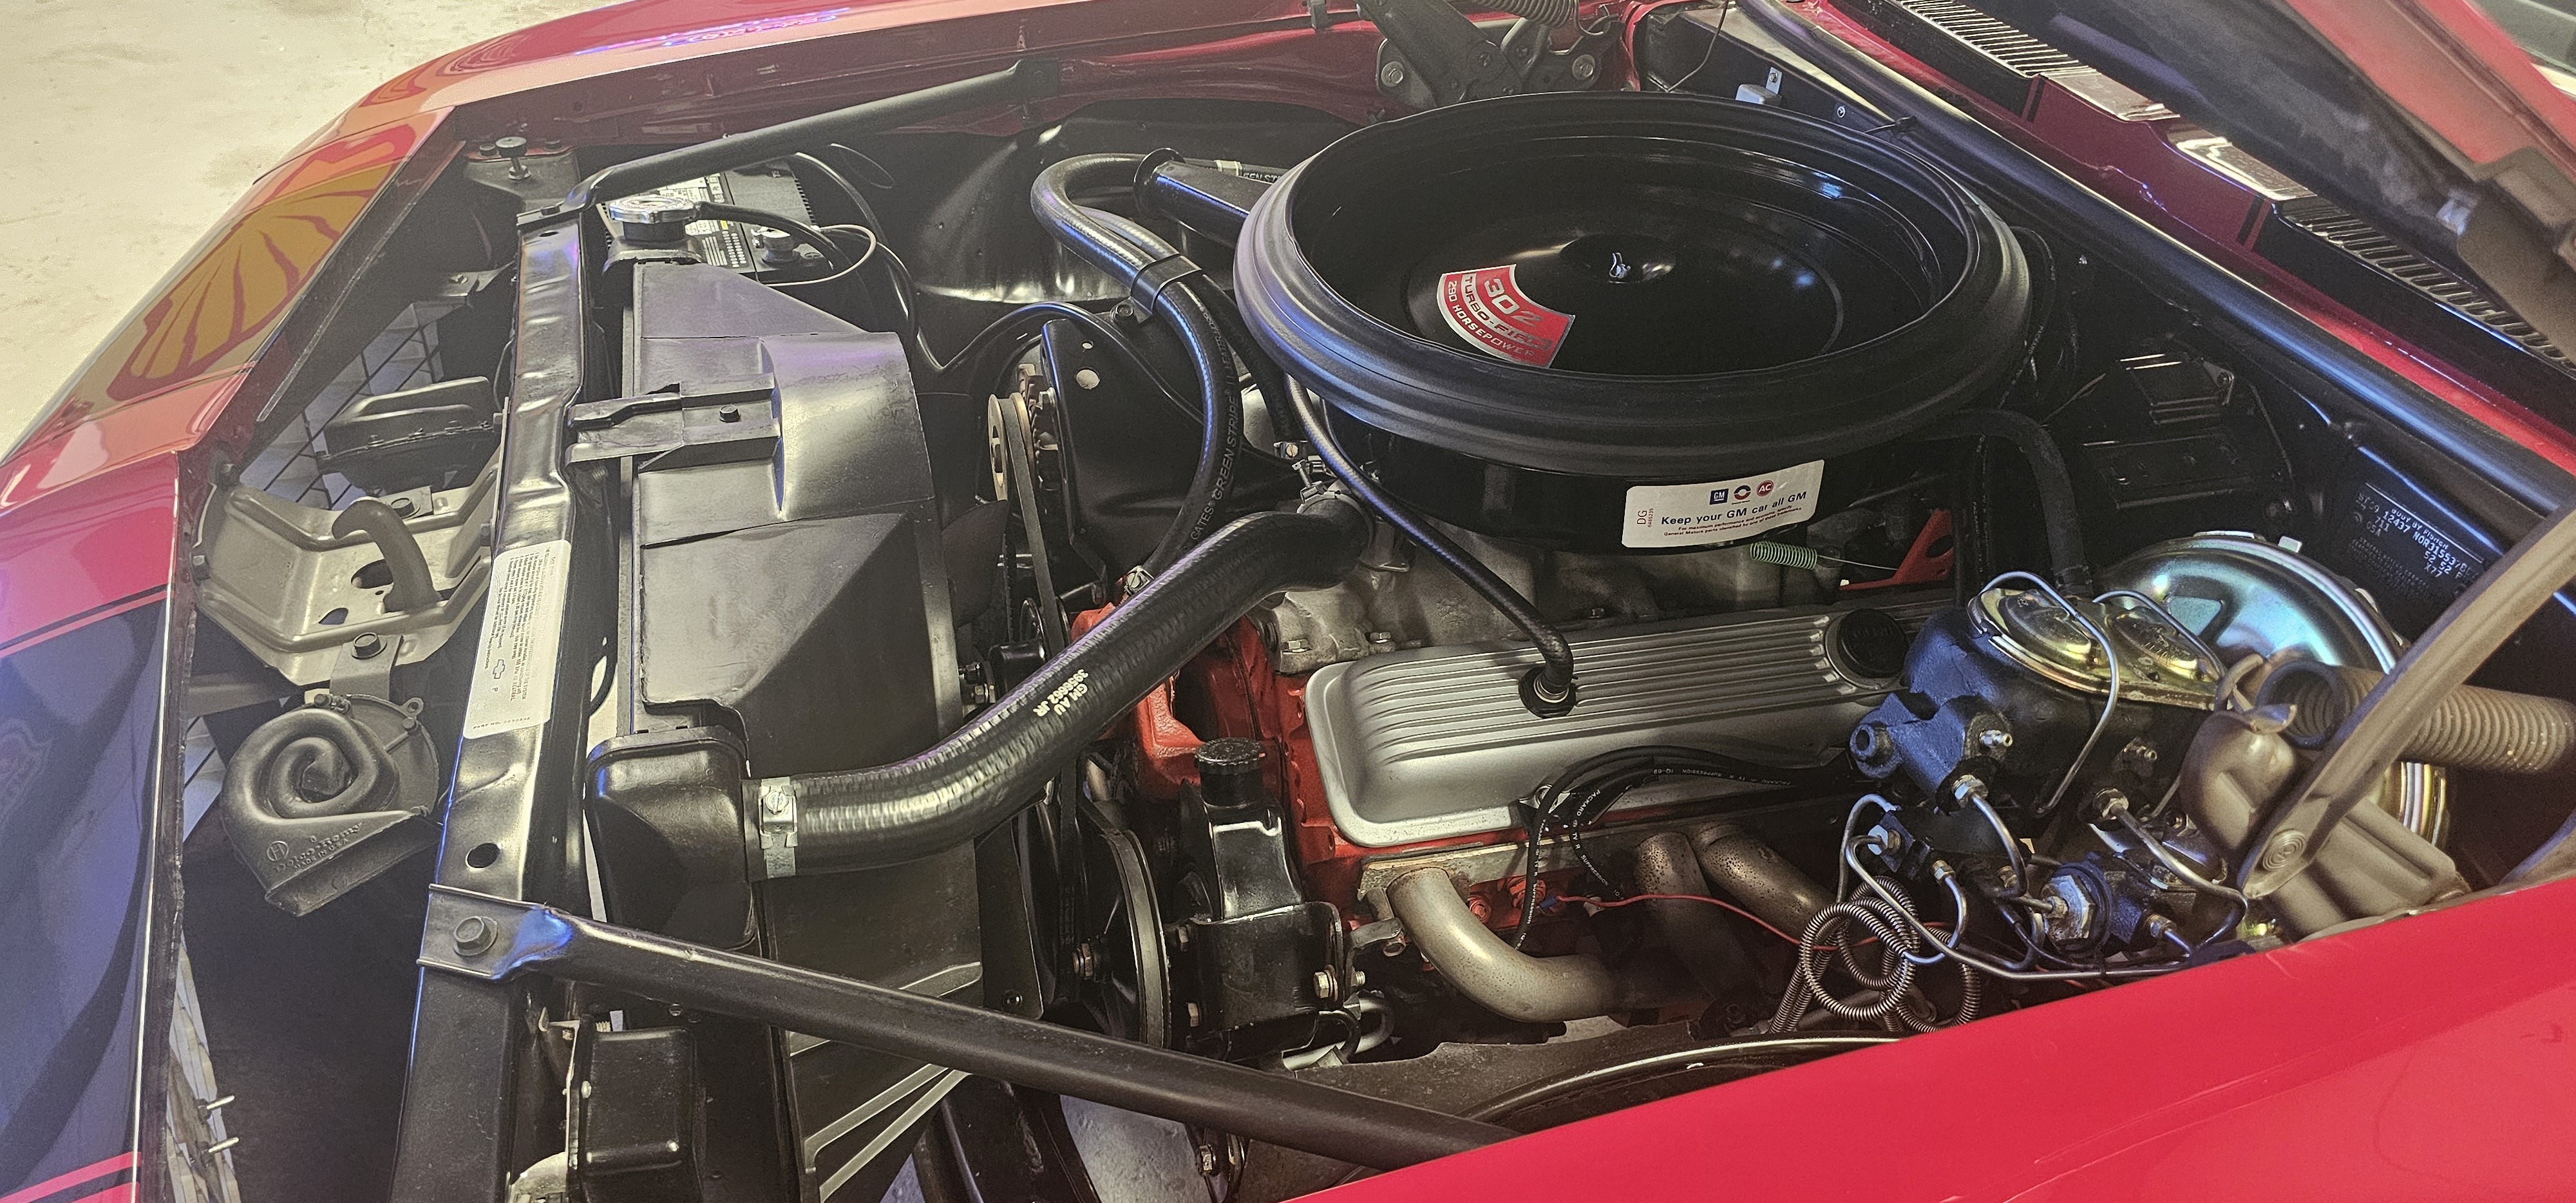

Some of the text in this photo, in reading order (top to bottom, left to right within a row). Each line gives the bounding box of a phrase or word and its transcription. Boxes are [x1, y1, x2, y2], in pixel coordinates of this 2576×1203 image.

[1464, 276, 1553, 351] TURBO-FIRE
[1484, 278, 1544, 327] 302
[1448, 280, 1536, 356] 290 HORSEPOWER
[1212, 448, 1235, 500] GREEN
[1662, 491, 1806, 525] Keep your GM car all GM
[1714, 491, 1725, 501] GM
[1636, 510, 1647, 525] DG
[2375, 516, 2389, 532] 711
[2383, 511, 2410, 533] 12437
[2423, 551, 2452, 574] 52 52
[2424, 562, 2442, 578] X77
[1033, 669, 1089, 717] 3956662 JR
[1054, 683, 1088, 715] GM AU
[1577, 789, 1601, 817] PACKARD
[1572, 832, 1578, 840] TV
